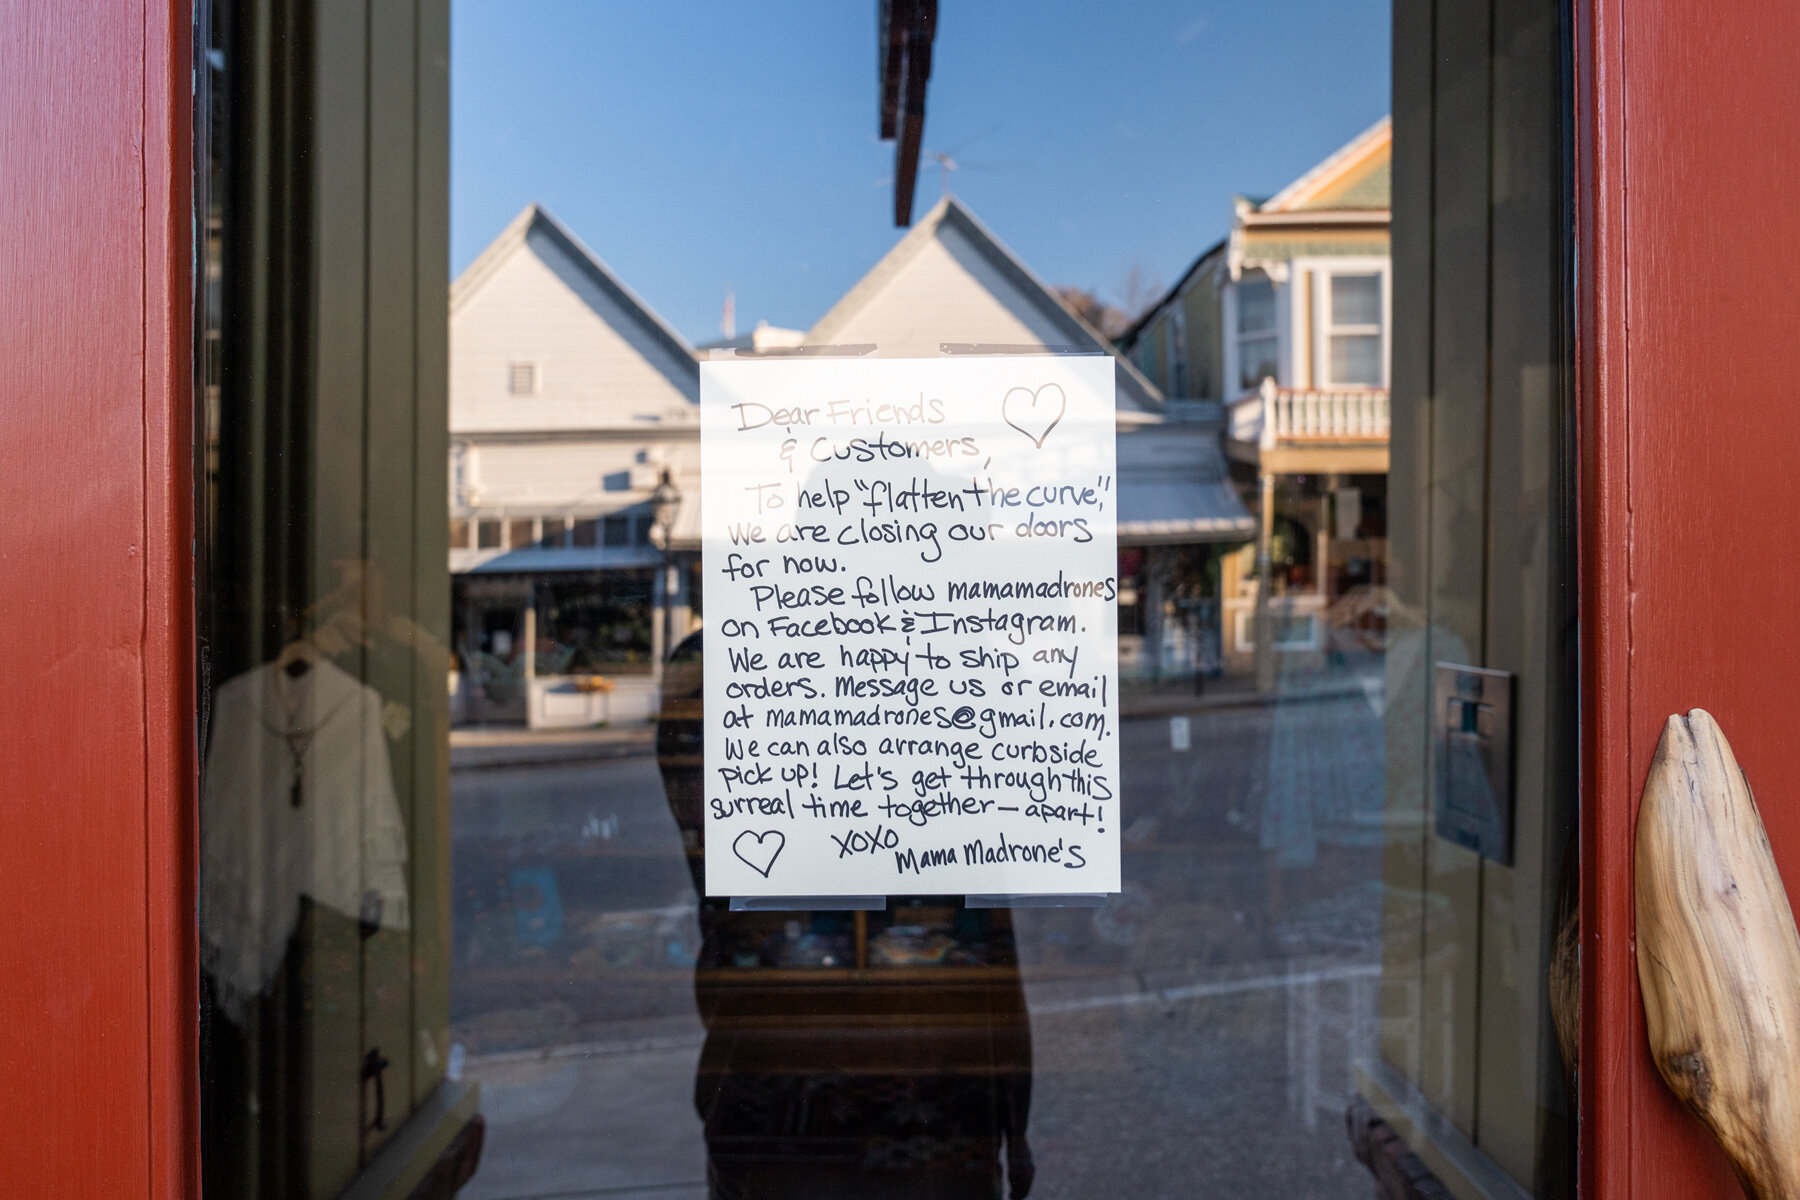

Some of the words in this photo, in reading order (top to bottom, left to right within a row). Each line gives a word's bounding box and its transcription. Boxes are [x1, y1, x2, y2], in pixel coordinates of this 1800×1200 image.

[731, 403, 819, 431] Dear
[827, 392, 945, 425] Friends
[744, 482, 784, 514] To
[798, 478, 850, 515] help
[962, 477, 1023, 508] the
[728, 524, 766, 547] We
[776, 524, 830, 544] are
[837, 518, 942, 563] closing
[948, 524, 1004, 541] our
[1015, 513, 1093, 542] doors
[722, 553, 770, 581] for
[784, 554, 847, 574] now.
[749, 581, 845, 612] Please
[852, 574, 935, 608] follow
[947, 570, 1116, 603] mamamadrones
[721, 617, 759, 638] on
[768, 612, 897, 638] Facebook
[913, 610, 1087, 645] Instagram.
[728, 647, 766, 672] We
[778, 651, 825, 668] are
[840, 645, 909, 676] happy
[915, 643, 951, 670] to
[960, 646, 1019, 671] ship
[1032, 645, 1078, 678] any
[726, 676, 825, 700] orders.
[948, 680, 986, 696] us
[1001, 680, 1032, 696] or
[1039, 675, 1107, 707] email
[723, 705, 755, 729] at
[726, 738, 759, 760] We
[768, 739, 810, 756] can
[817, 733, 867, 755] also
[878, 738, 983, 768] arrange
[991, 738, 1102, 768] curbside
[781, 762, 819, 788] up!
[834, 762, 898, 791] Let's
[912, 767, 952, 795] get
[960, 766, 1062, 802] through
[1061, 764, 1112, 801] this
[802, 793, 868, 818] time
[1025, 800, 1105, 834] apart!
[895, 848, 957, 874] Mama
[964, 832, 1087, 869] Madrone's
